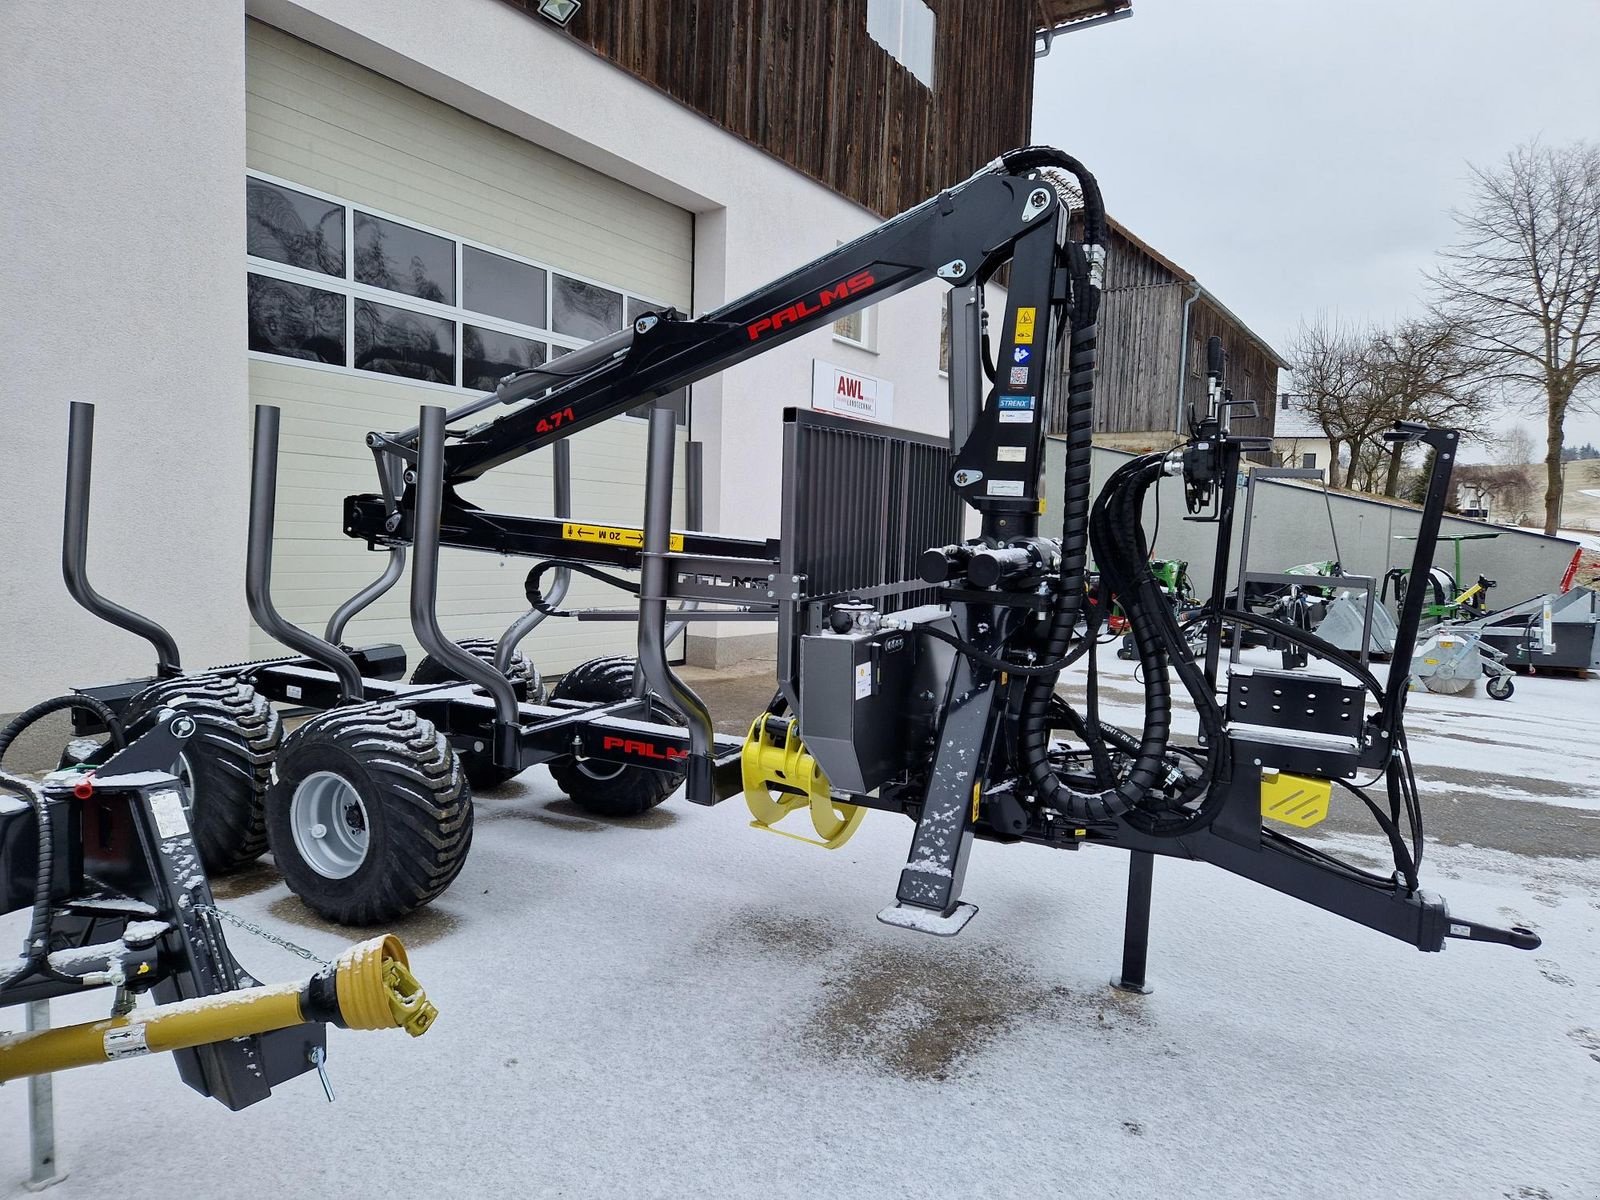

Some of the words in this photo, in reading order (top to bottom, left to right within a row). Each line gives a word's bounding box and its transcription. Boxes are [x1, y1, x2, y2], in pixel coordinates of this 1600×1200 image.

[747, 270, 875, 340] PALMS
[837, 375, 864, 401] AWL
[536, 407, 575, 433] 4.71
[598, 530, 607, 539] M
[609, 531, 621, 541] 20
[677, 572, 769, 590] PALMS
[603, 735, 689, 760] PALM
